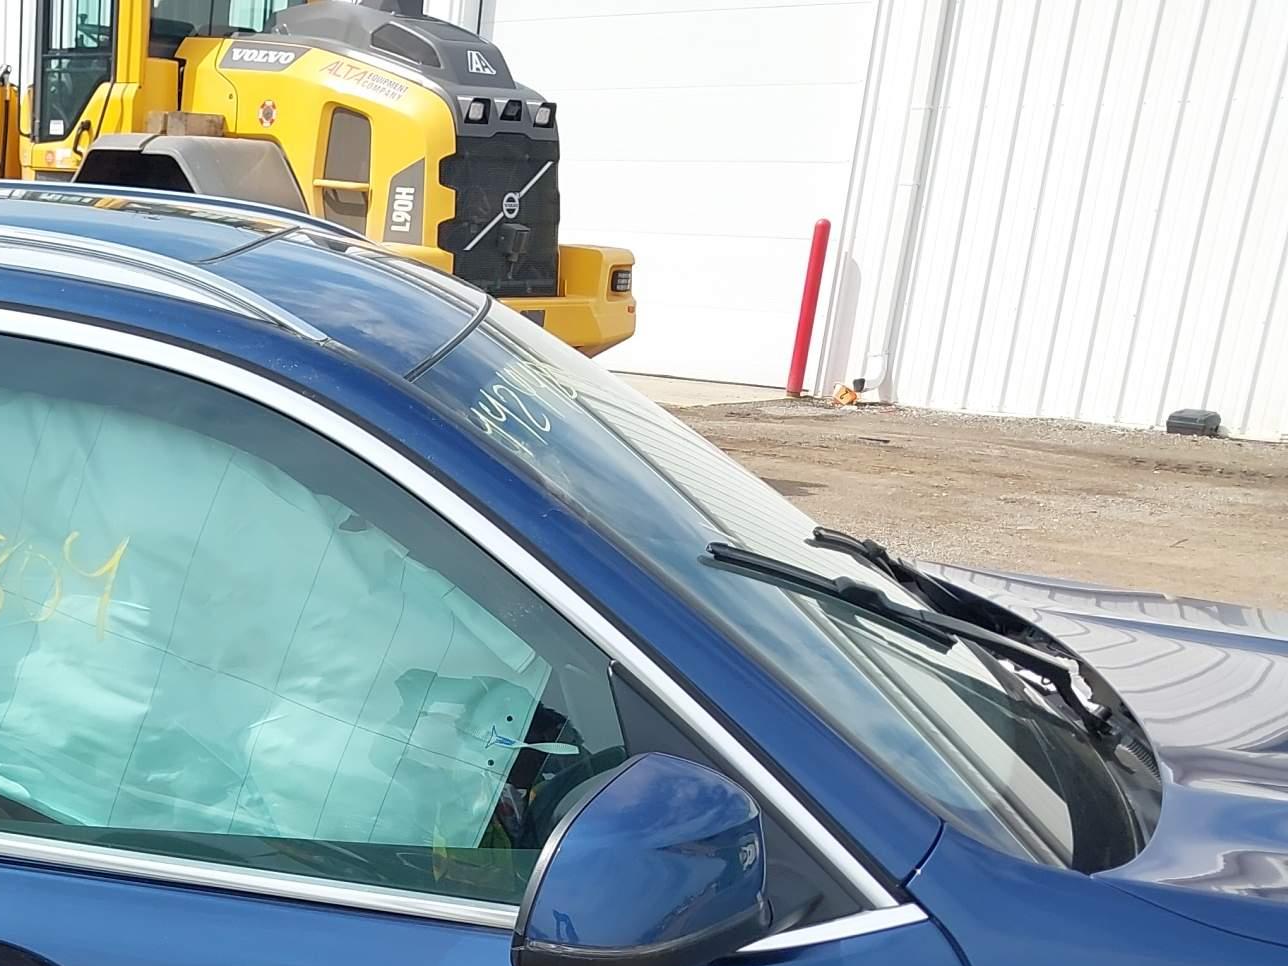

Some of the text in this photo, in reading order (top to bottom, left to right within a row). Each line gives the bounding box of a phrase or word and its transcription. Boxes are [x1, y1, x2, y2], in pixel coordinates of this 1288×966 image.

[231, 48, 295, 65] VOLVO
[320, 60, 368, 86] ALTA
[366, 72, 410, 95] EQUIPMENT
[361, 79, 403, 101] COMPANY
[390, 187, 415, 232] L90H
